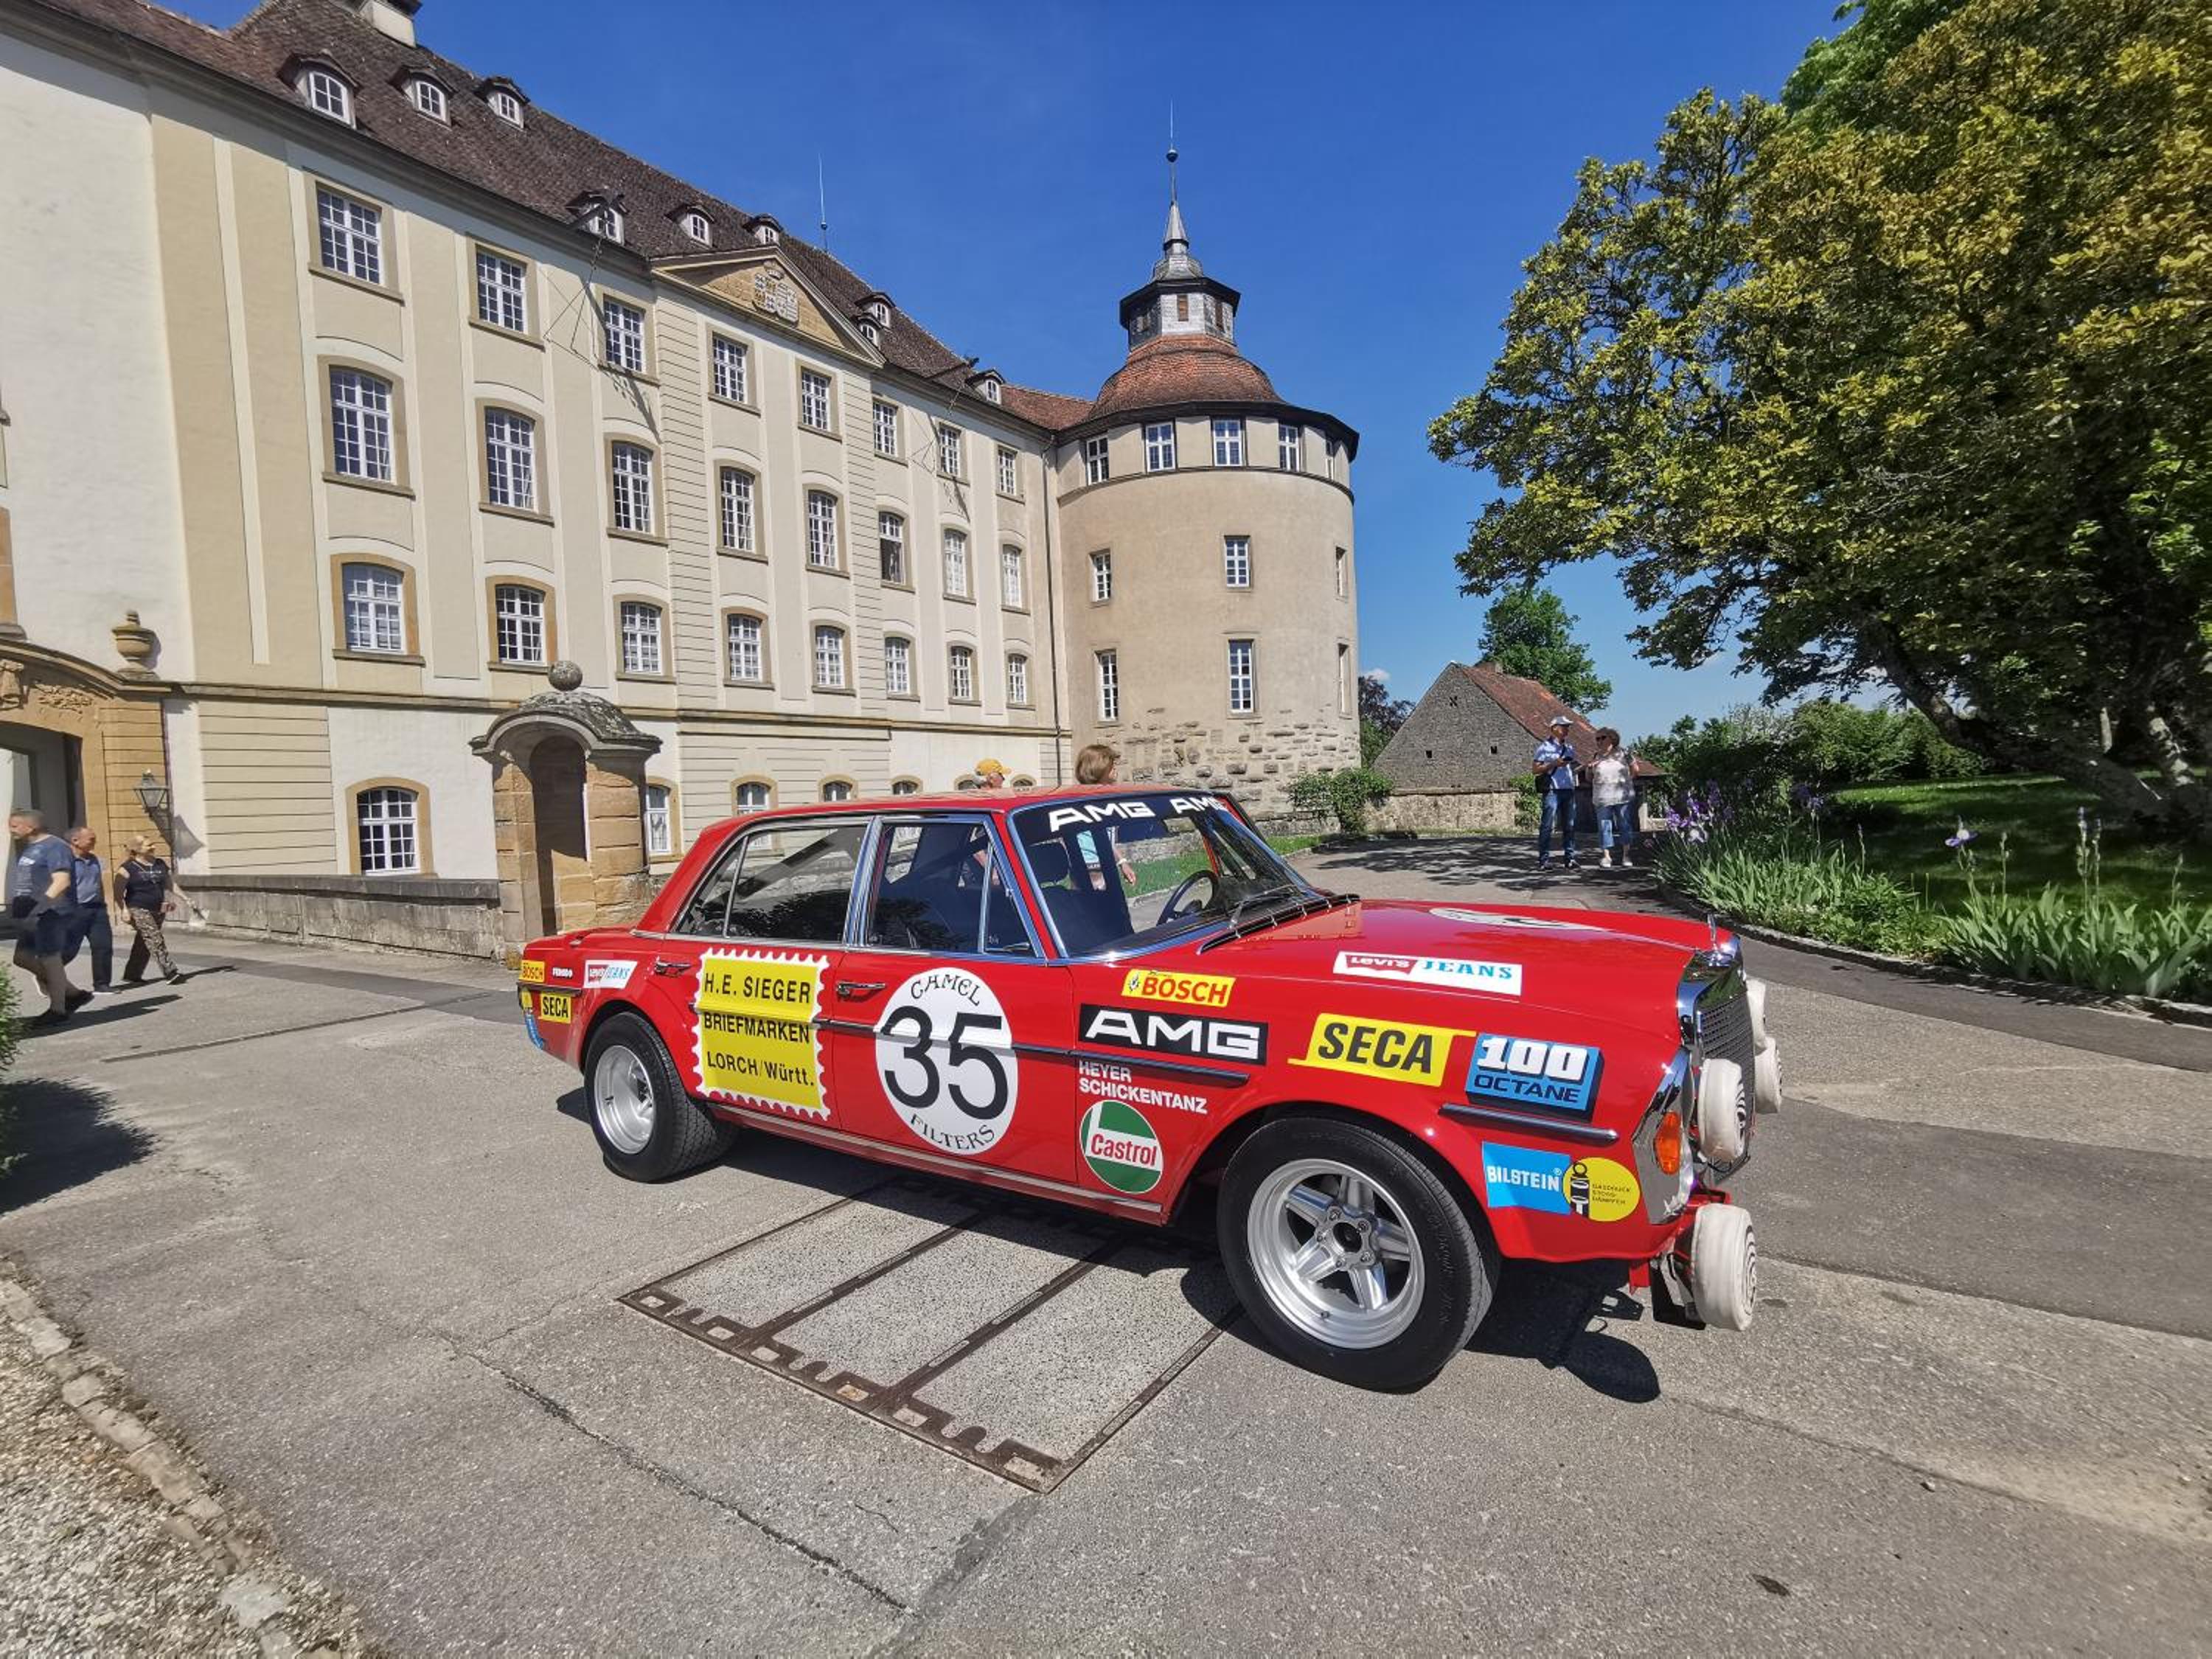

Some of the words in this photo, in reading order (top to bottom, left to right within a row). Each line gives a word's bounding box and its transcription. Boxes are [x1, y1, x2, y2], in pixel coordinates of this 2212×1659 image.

[1048, 801, 1156, 832] AMG
[523, 964, 543, 979] BOSCH
[1423, 960, 1512, 980] JEANS
[704, 973, 737, 996] H.E.
[743, 975, 811, 1004] SIEGER
[911, 974, 981, 1006] CAMEL
[1141, 977, 1228, 1004] BOSCH
[543, 996, 568, 1018] SECA
[704, 1012, 810, 1043] BRIEFMARKEN
[1085, 1011, 1260, 1059] AMG
[884, 1006, 1009, 1119] 35
[1318, 1023, 1433, 1074] SECA
[1477, 1035, 1587, 1081] 100
[1079, 1060, 1132, 1082] HEYER
[1079, 1078, 1208, 1115] SCHICKENTANZ
[1474, 1074, 1581, 1103] OCTANE
[910, 1113, 995, 1150] FILTERS
[1091, 1133, 1157, 1166] Castrol
[1486, 1166, 1559, 1192] BILSTEIN
